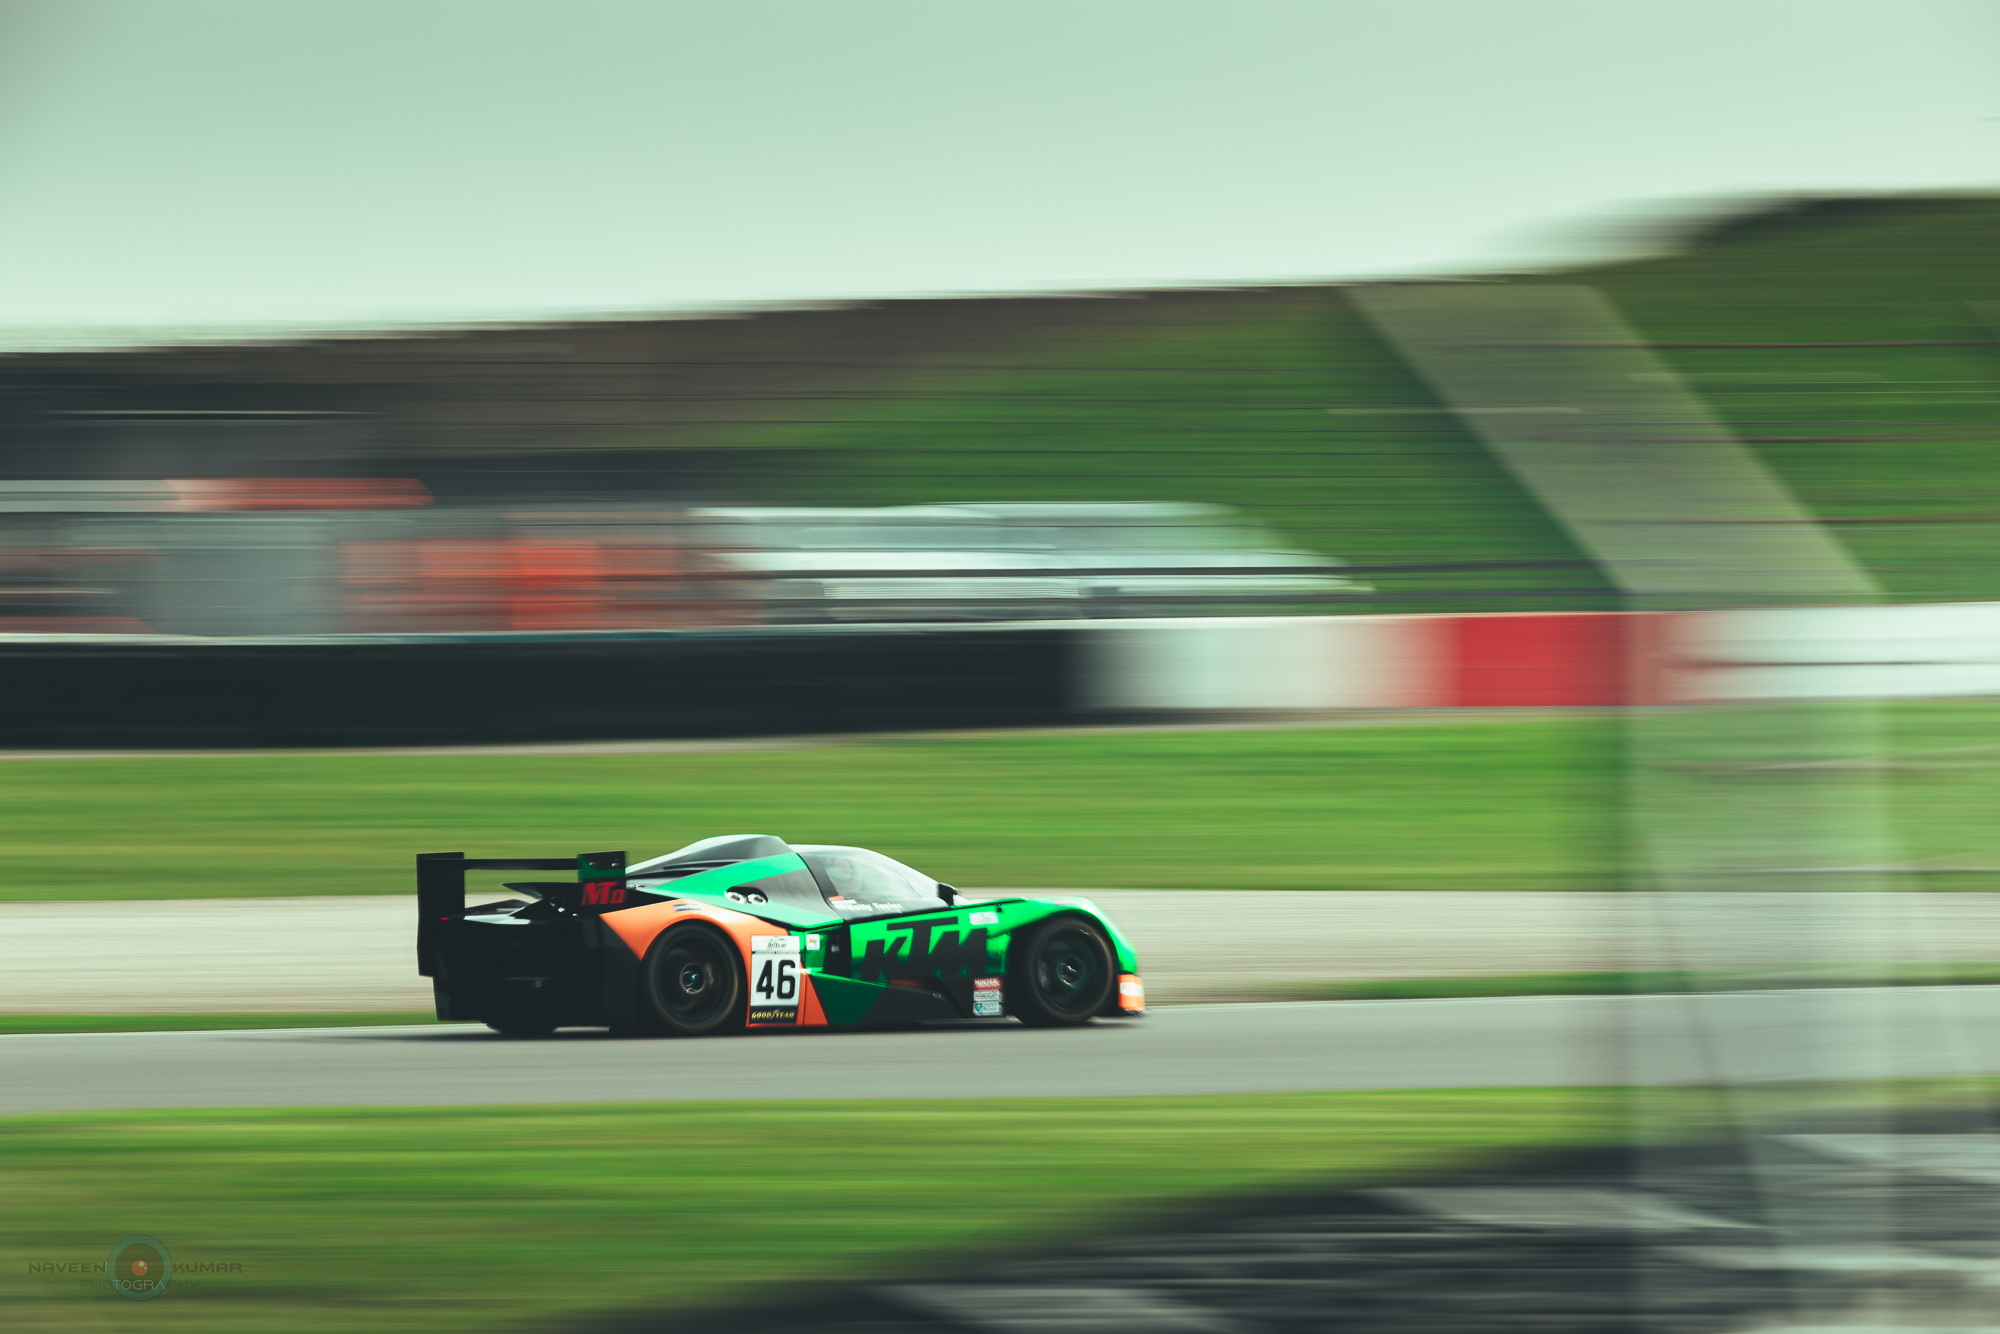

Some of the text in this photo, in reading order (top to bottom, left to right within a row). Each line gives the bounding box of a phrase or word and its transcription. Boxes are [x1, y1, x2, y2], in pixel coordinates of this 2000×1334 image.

[861, 916, 987, 982] KTM
[756, 959, 796, 1000] 46
[751, 1008, 795, 1019] GOODYEAR
